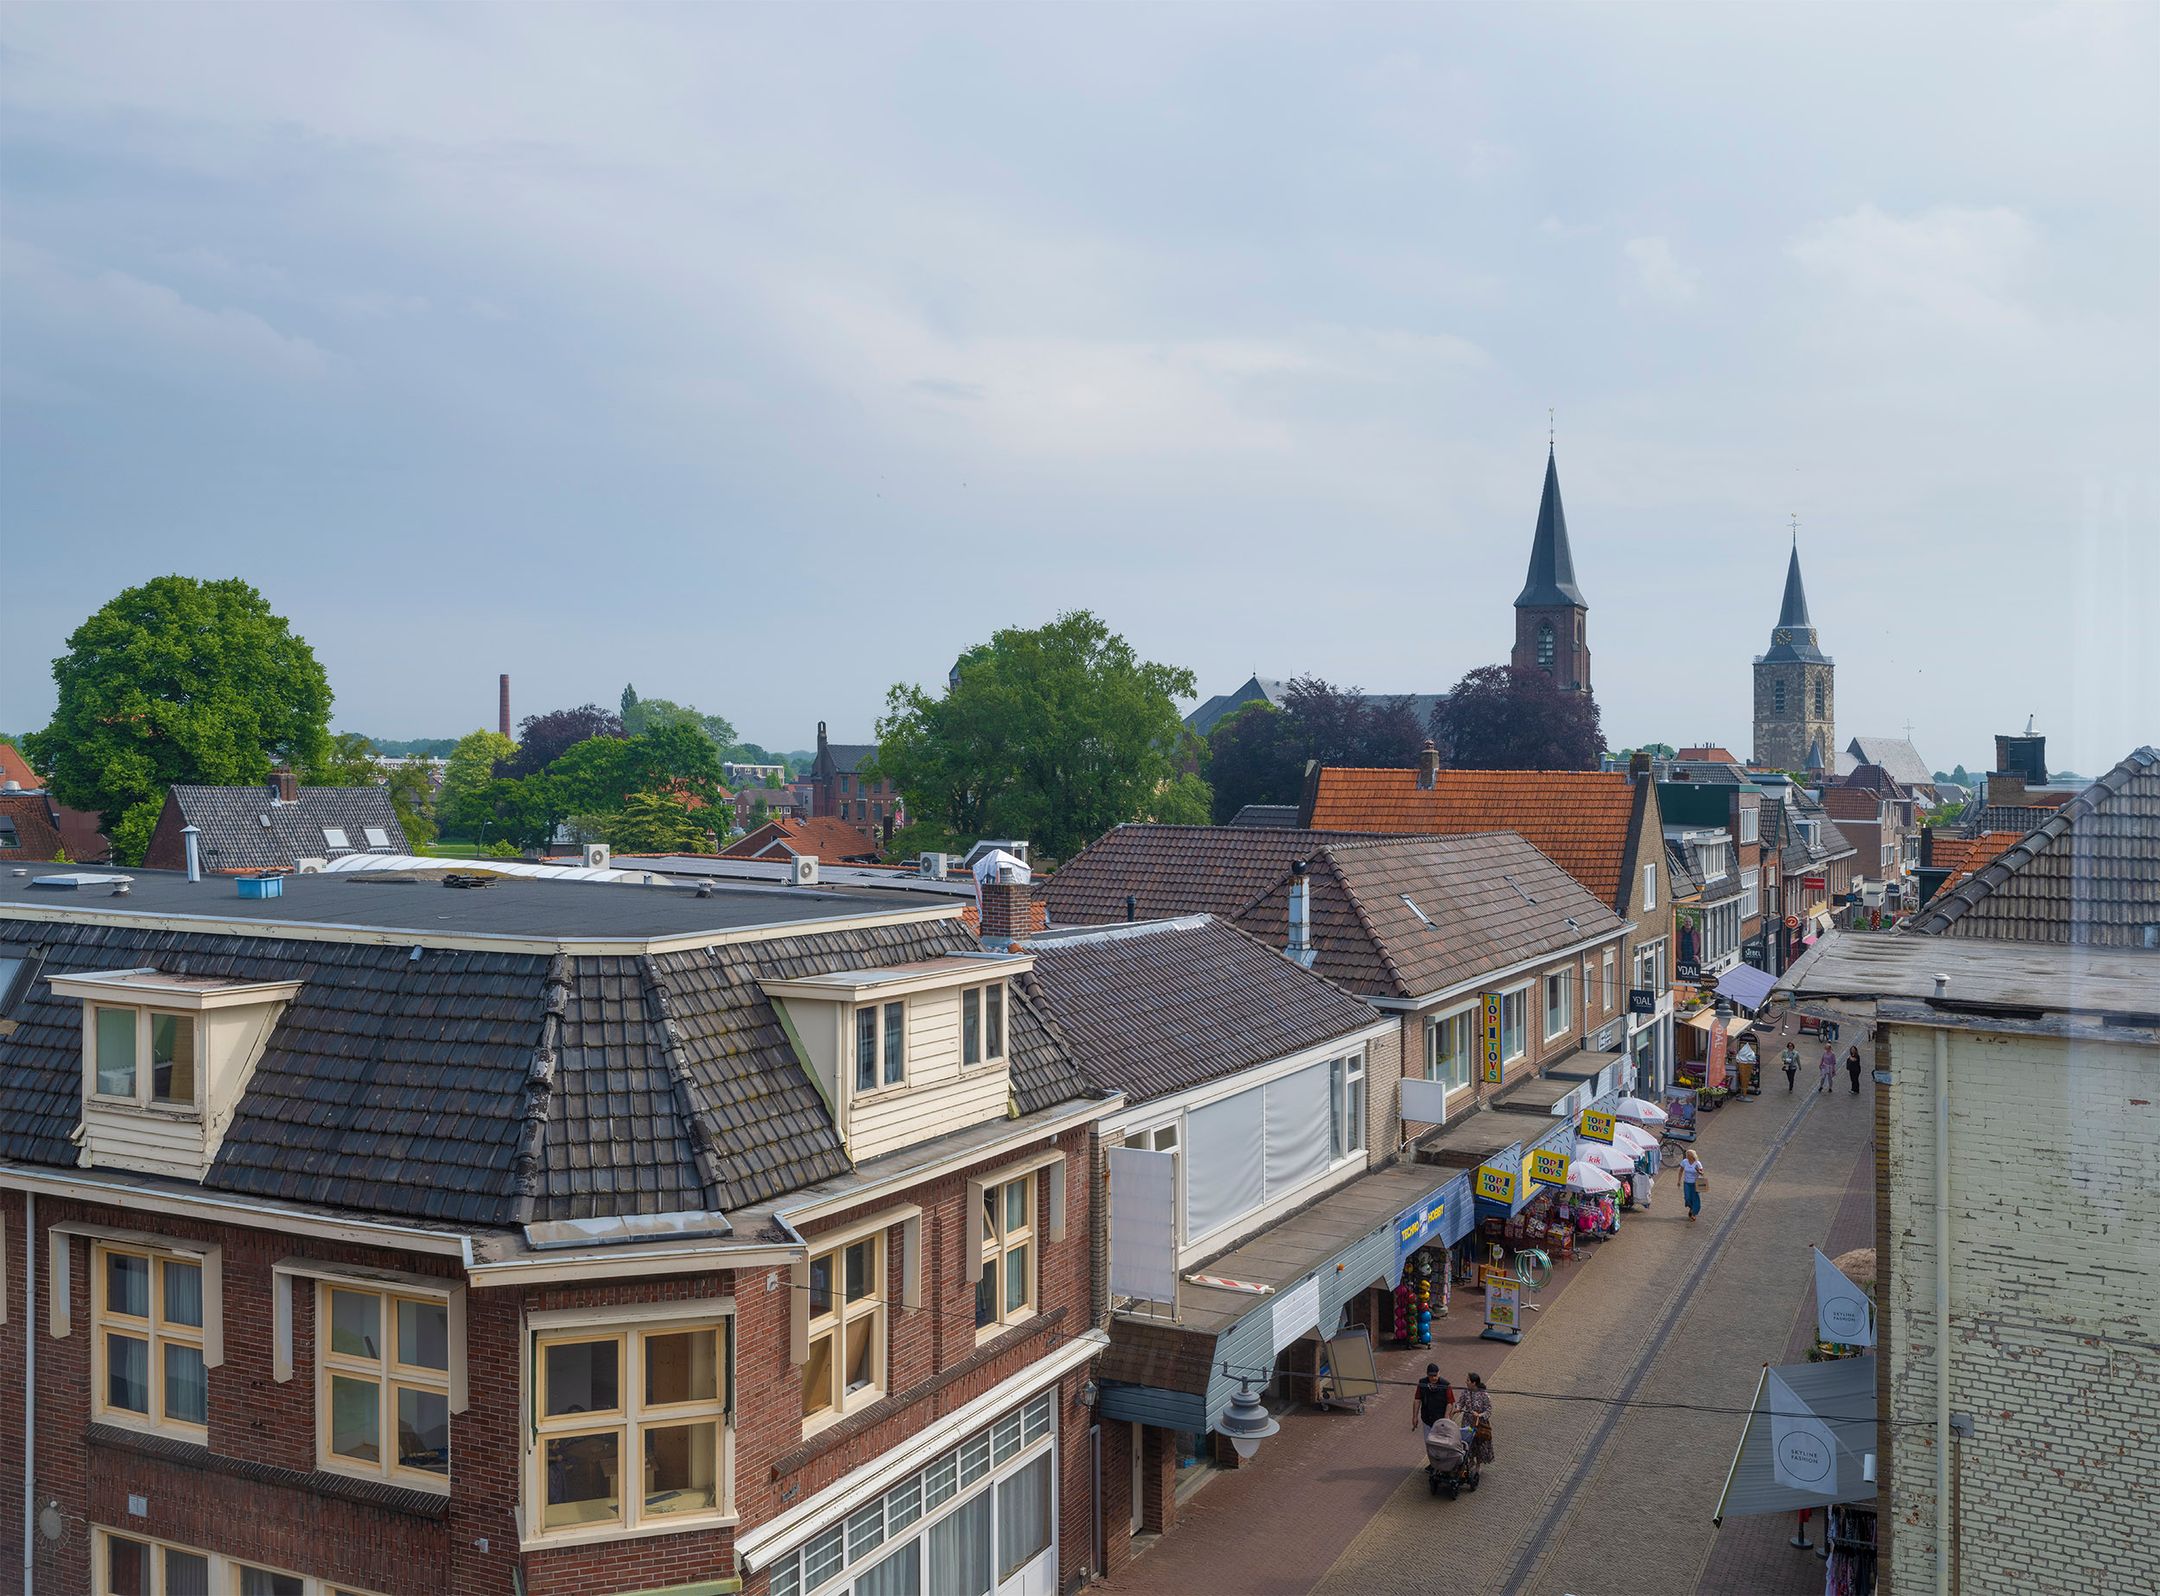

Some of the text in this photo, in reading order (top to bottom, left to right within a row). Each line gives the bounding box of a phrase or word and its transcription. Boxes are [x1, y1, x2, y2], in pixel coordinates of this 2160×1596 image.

[1488, 995, 1497, 1079] TOP 1 TOYS
[1586, 1115, 1611, 1127] TOP 1
[1587, 1124, 1609, 1135] TOYS
[1537, 1155, 1564, 1169] TOP 1
[1537, 1165, 1562, 1177] TOYS
[1483, 1172, 1510, 1188] TOP 1
[1483, 1182, 1508, 1196] TOYS
[1401, 1204, 1444, 1241] TECHNO HOBBY
[1791, 1449, 1817, 1459] SKYLINE
[1791, 1455, 1818, 1464] FASHION
